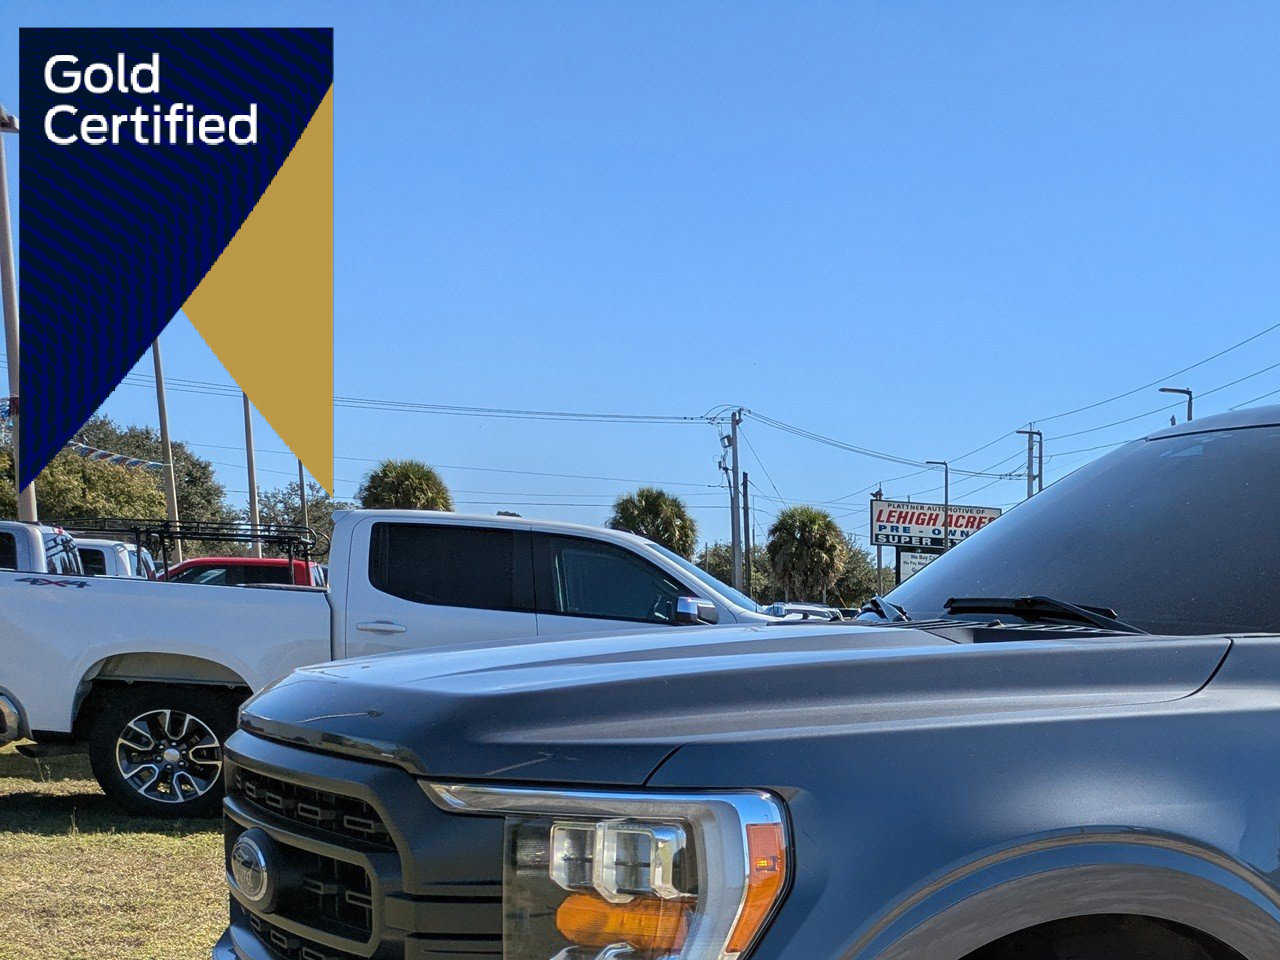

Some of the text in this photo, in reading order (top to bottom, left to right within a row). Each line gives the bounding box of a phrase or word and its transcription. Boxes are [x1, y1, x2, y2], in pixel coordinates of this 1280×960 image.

[887, 503, 925, 511] PLATTNER
[927, 506, 974, 514] AUTOMOTIVE
[876, 509, 940, 526] LEHIGH
[877, 535, 932, 546] SUPER
